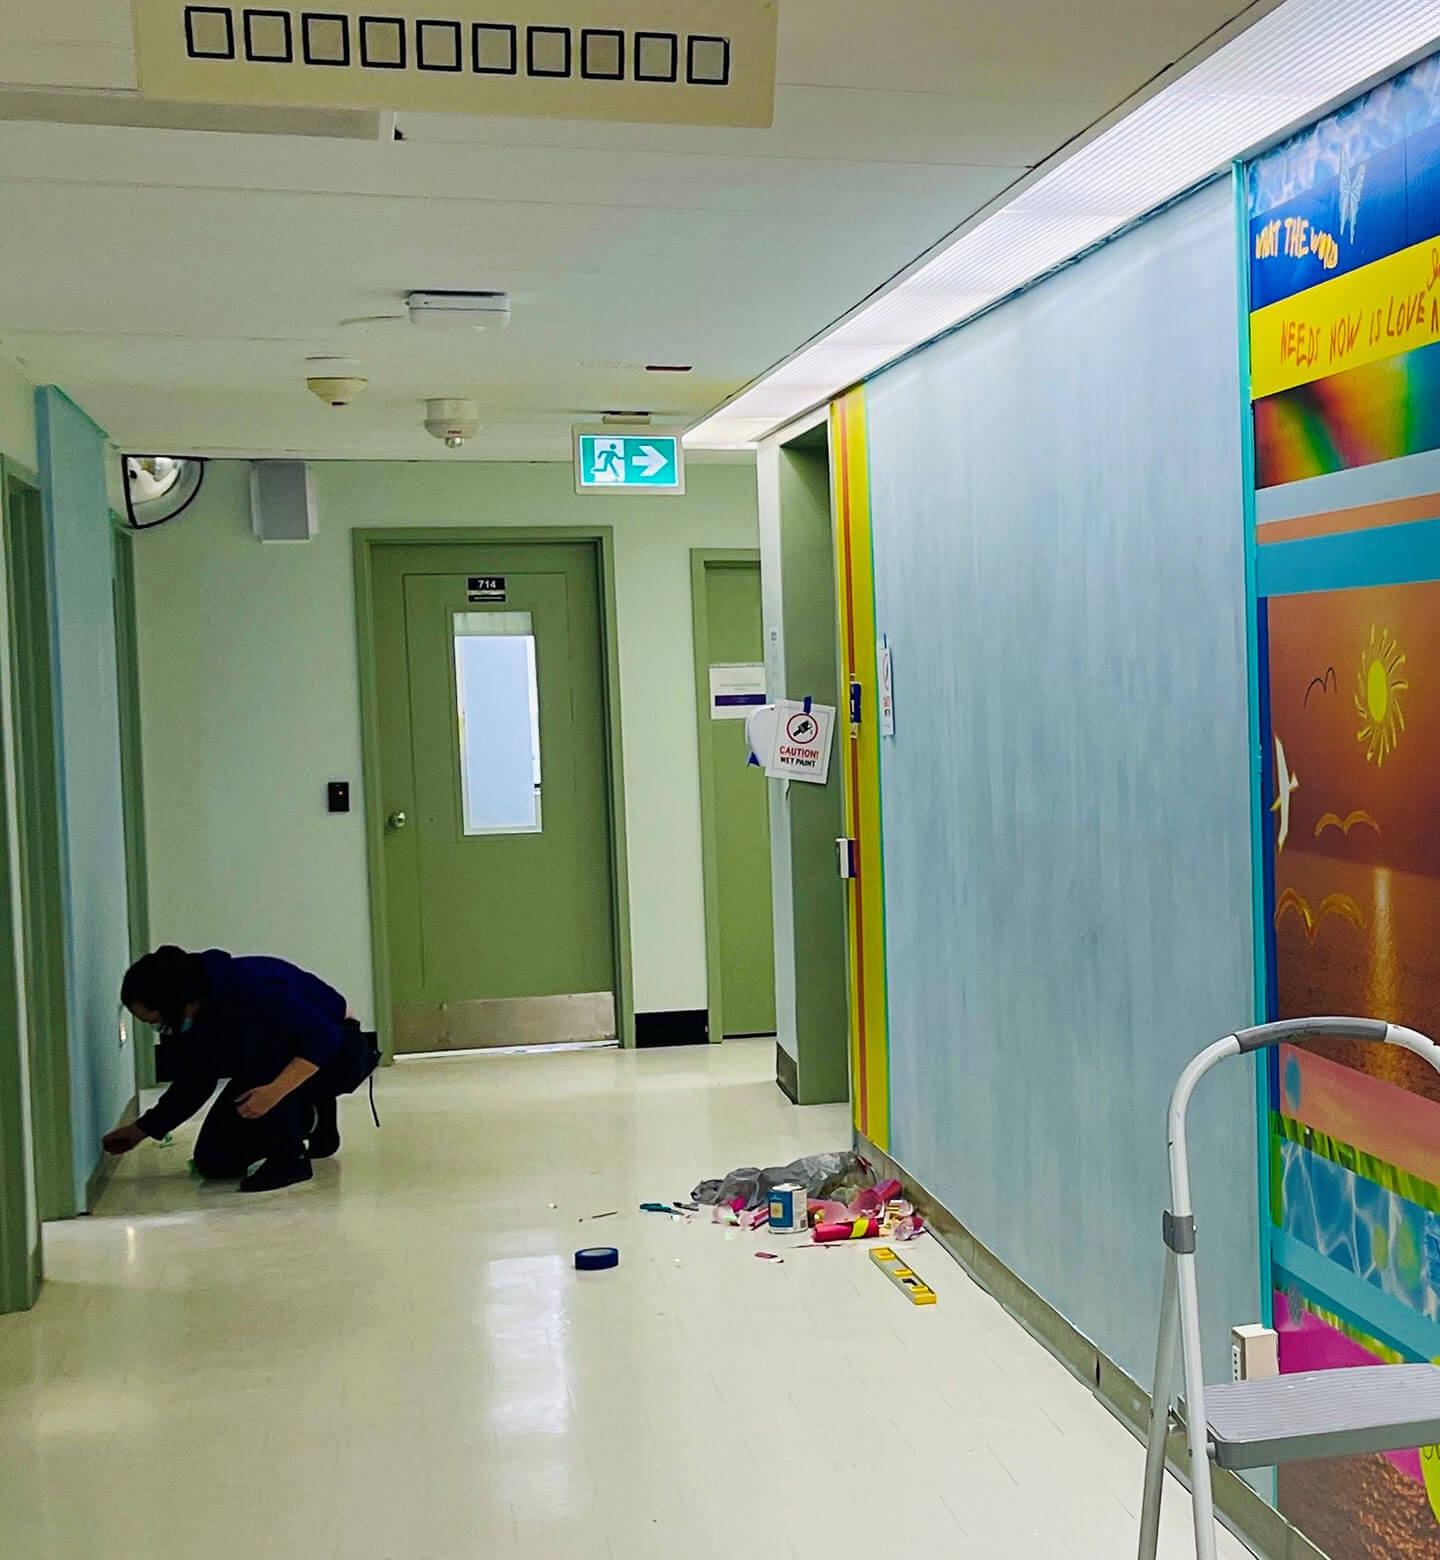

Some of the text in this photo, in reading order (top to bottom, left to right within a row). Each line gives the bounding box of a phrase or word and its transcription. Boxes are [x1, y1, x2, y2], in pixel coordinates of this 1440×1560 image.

[1284, 216, 1309, 258] THE
[1281, 320, 1320, 369] NEEDS
[1329, 309, 1363, 364] NOW
[1369, 308, 1382, 346] IS
[1386, 290, 1426, 337] LOVE
[477, 579, 497, 589] 714
[779, 745, 819, 759] CAUTION!
[780, 756, 816, 768] WET PAINT
